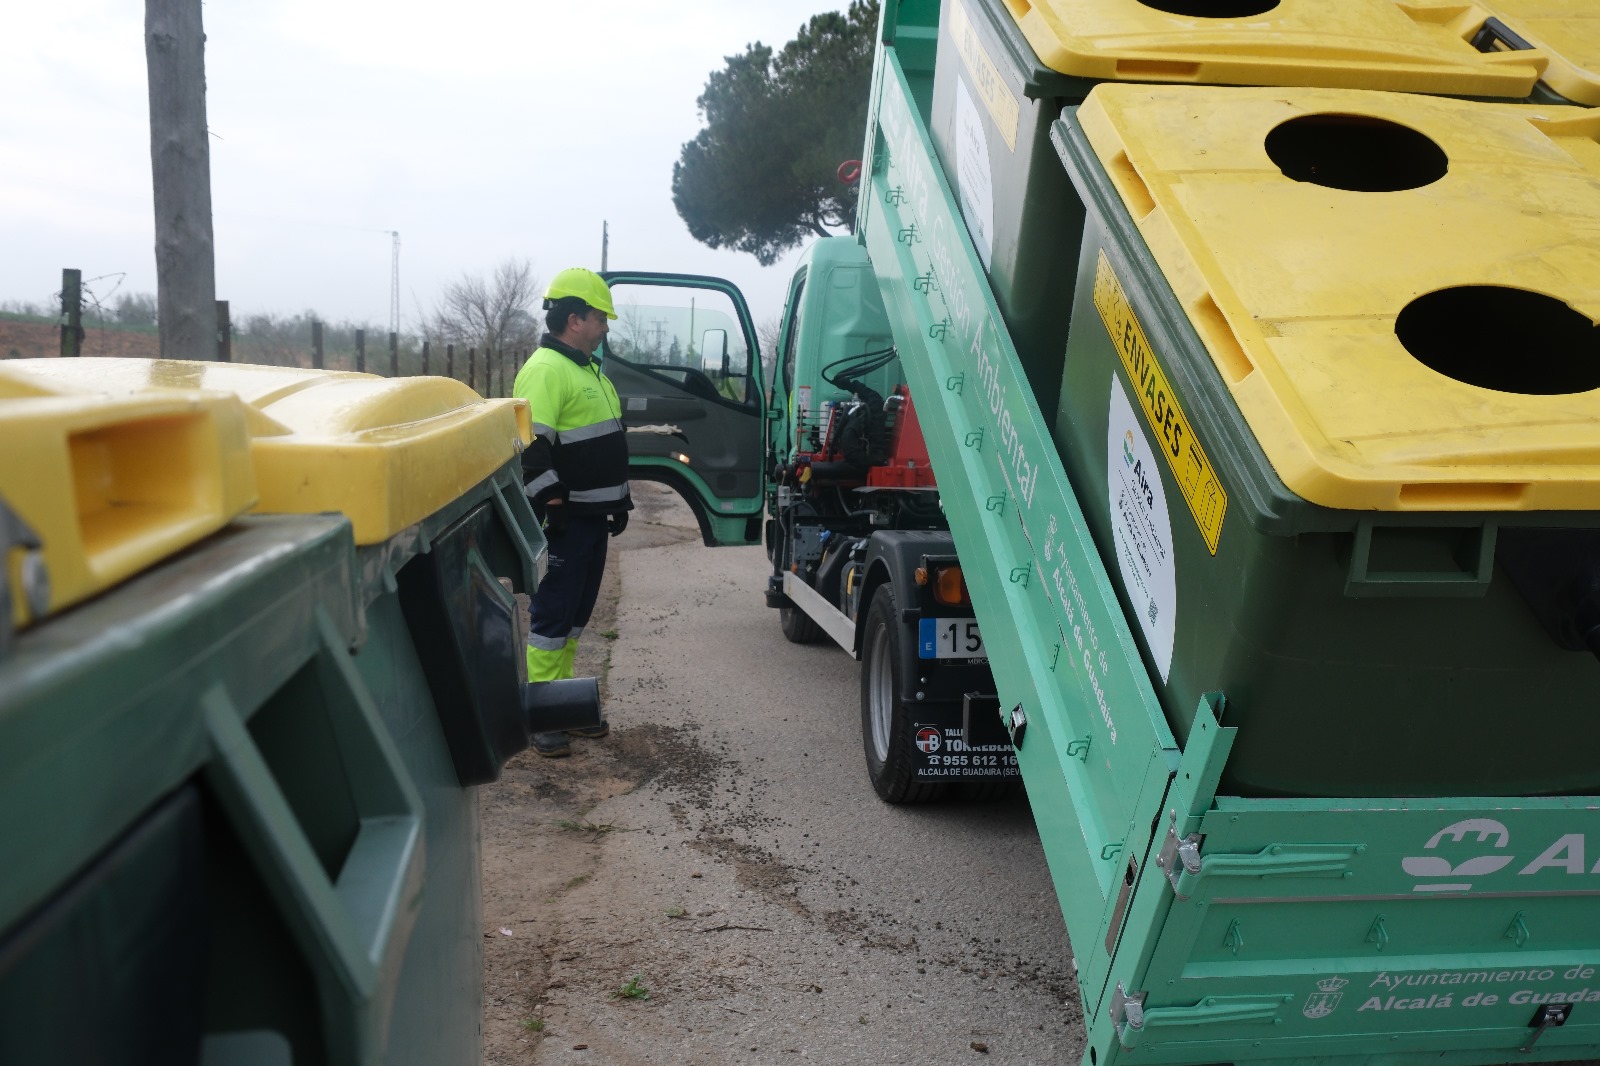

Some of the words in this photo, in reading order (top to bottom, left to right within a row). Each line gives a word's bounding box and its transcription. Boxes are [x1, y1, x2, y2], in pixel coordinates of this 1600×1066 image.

[963, 27, 995, 103] ENVASES
[933, 214, 970, 339] Gestión
[970, 320, 1038, 510] Ambiental
[1123, 318, 1183, 458] ENVASES
[1133, 459, 1154, 511] Aira
[1053, 567, 1074, 626] Alcalá
[1074, 624, 1083, 651] de
[1057, 541, 1098, 651] Ayuntamiento
[1098, 650, 1109, 676] de
[925, 642, 933, 651] E
[918, 768, 949, 776] ALCALA
[950, 768, 961, 776] DE
[962, 768, 1002, 776] GUADAIRA
[943, 755, 968, 766] 955
[972, 755, 998, 766] 612
[1517, 833, 1600, 875] A
[1369, 968, 1554, 992] Ayuntamiento
[1563, 963, 1595, 981] de
[1356, 992, 1454, 1012] Alcalá
[1461, 992, 1499, 1008] de
